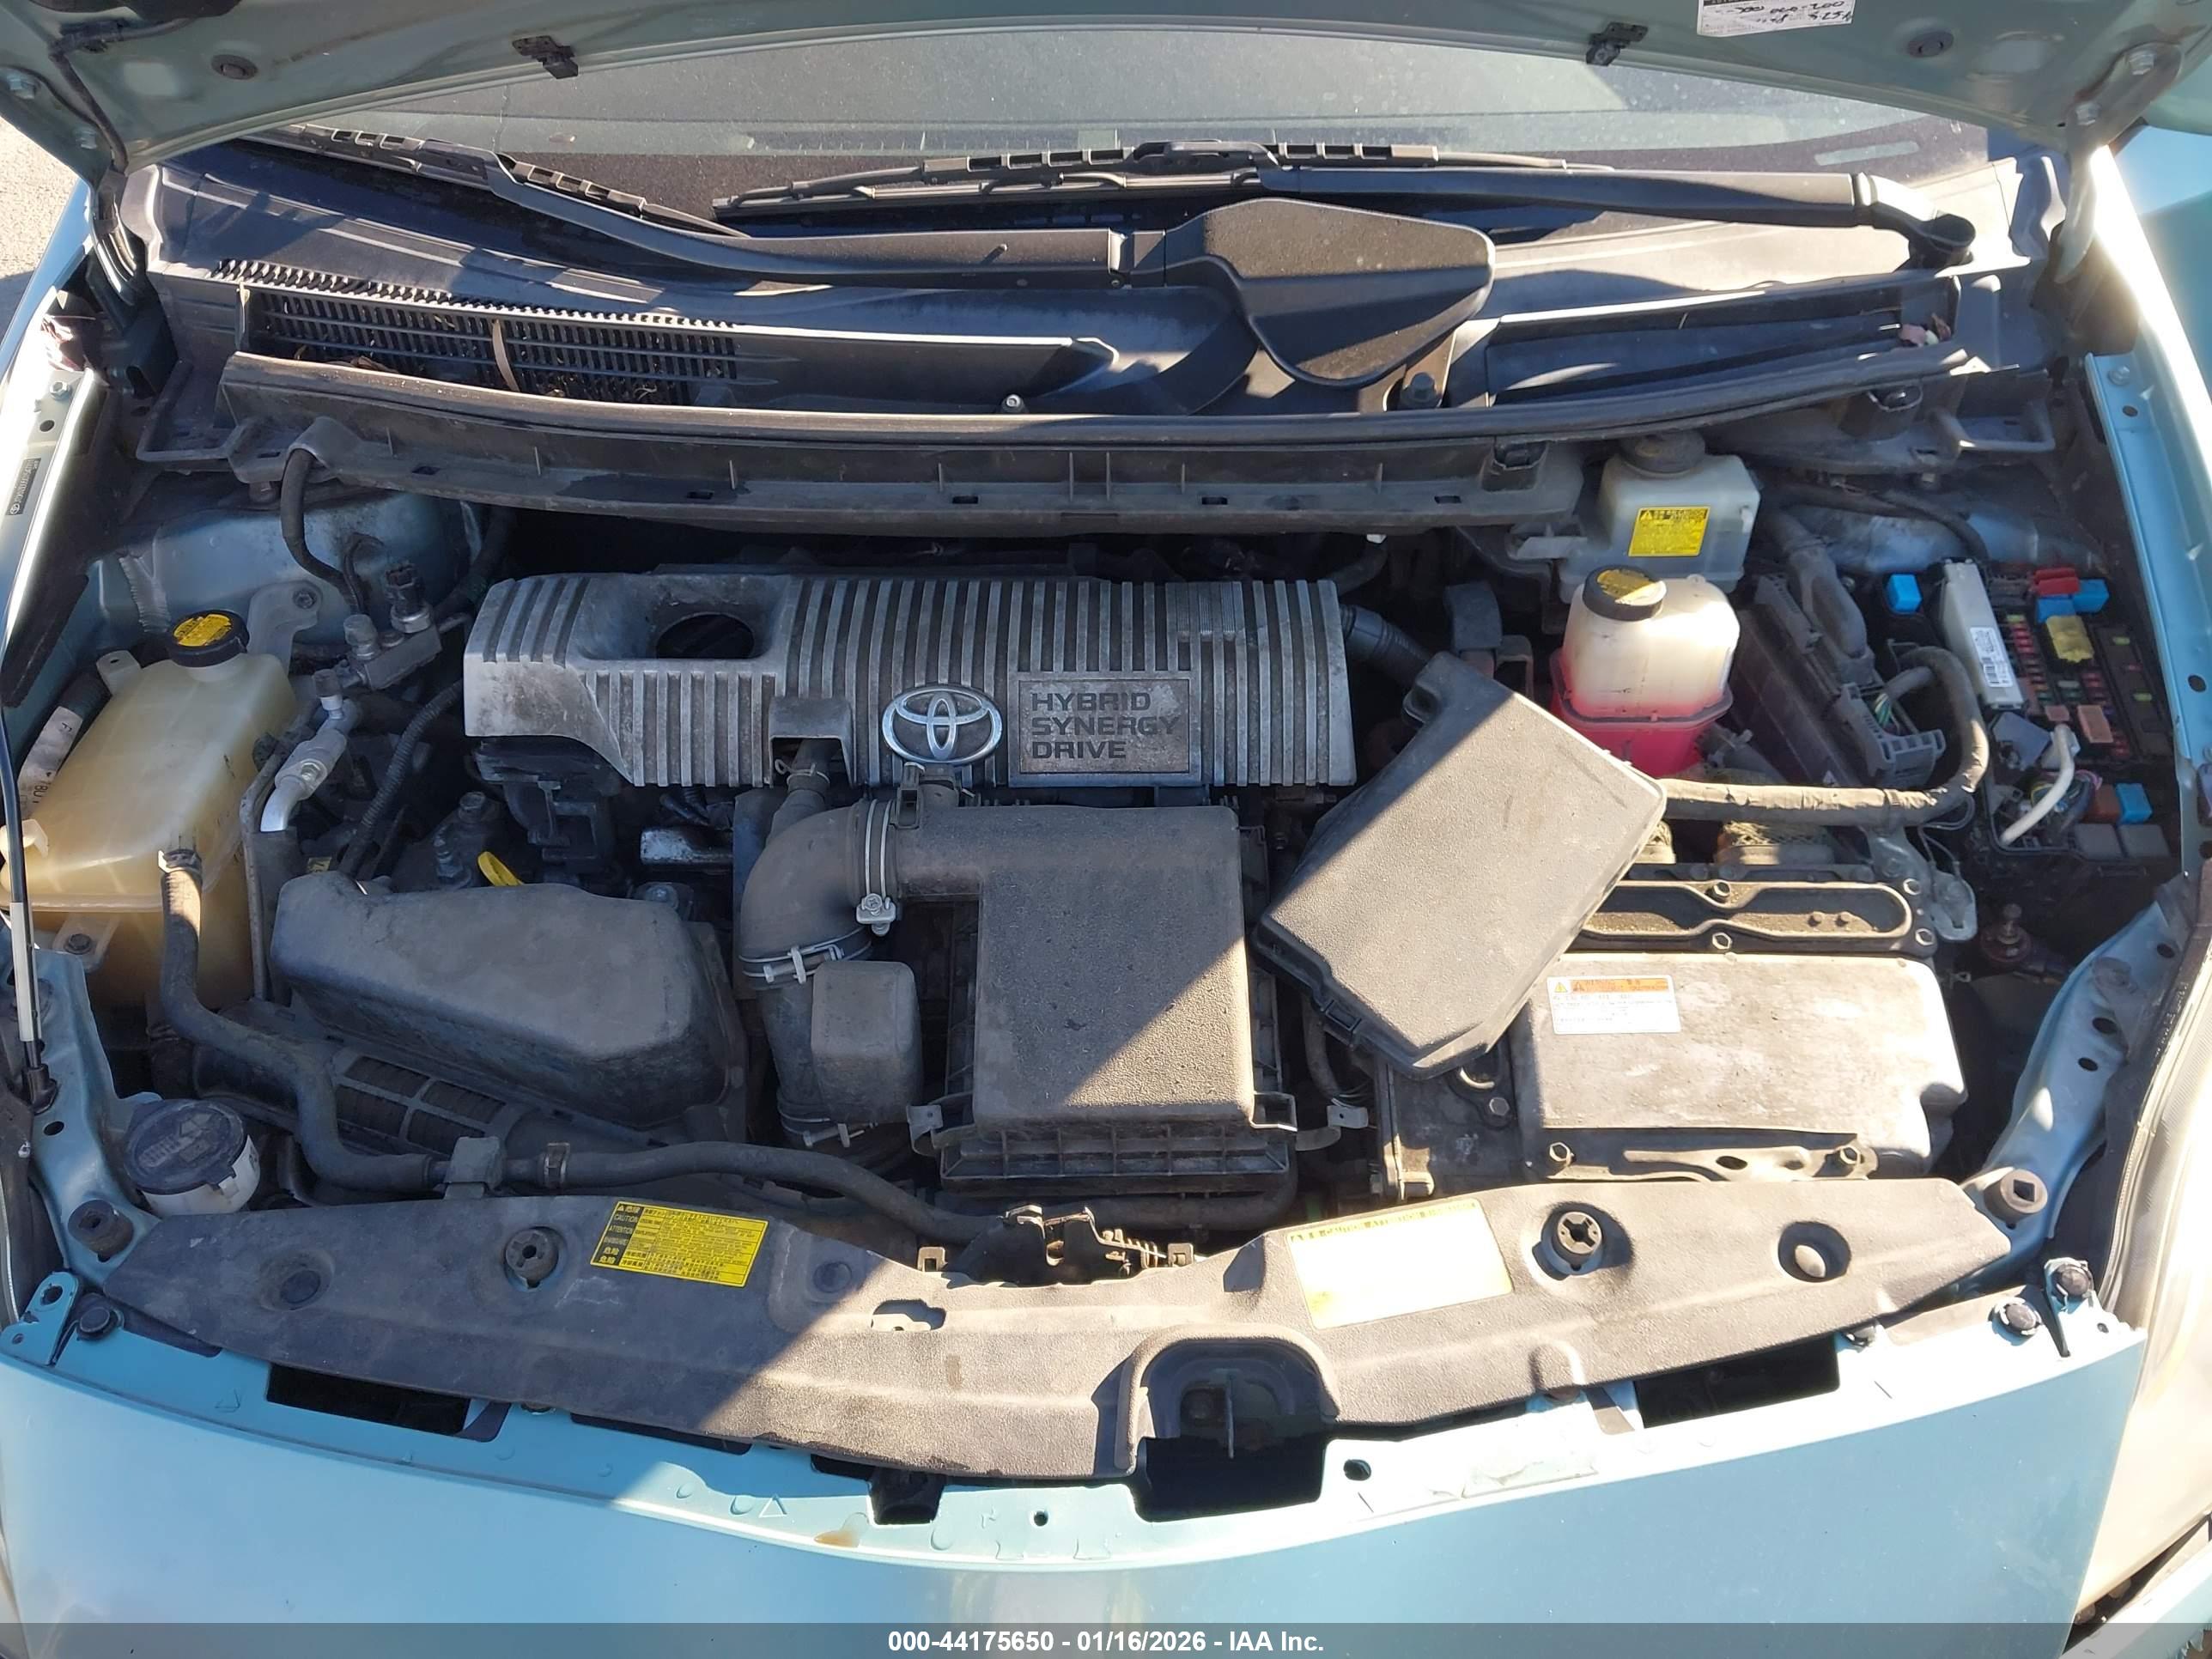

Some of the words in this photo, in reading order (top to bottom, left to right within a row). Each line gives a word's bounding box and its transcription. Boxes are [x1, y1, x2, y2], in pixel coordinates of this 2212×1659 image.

[1031, 692, 1152, 712] HYBRID
[1031, 715, 1182, 737] SYNERGY
[1032, 741, 1127, 759] DRIVE
[613, 1213, 639, 1223] CAUTION
